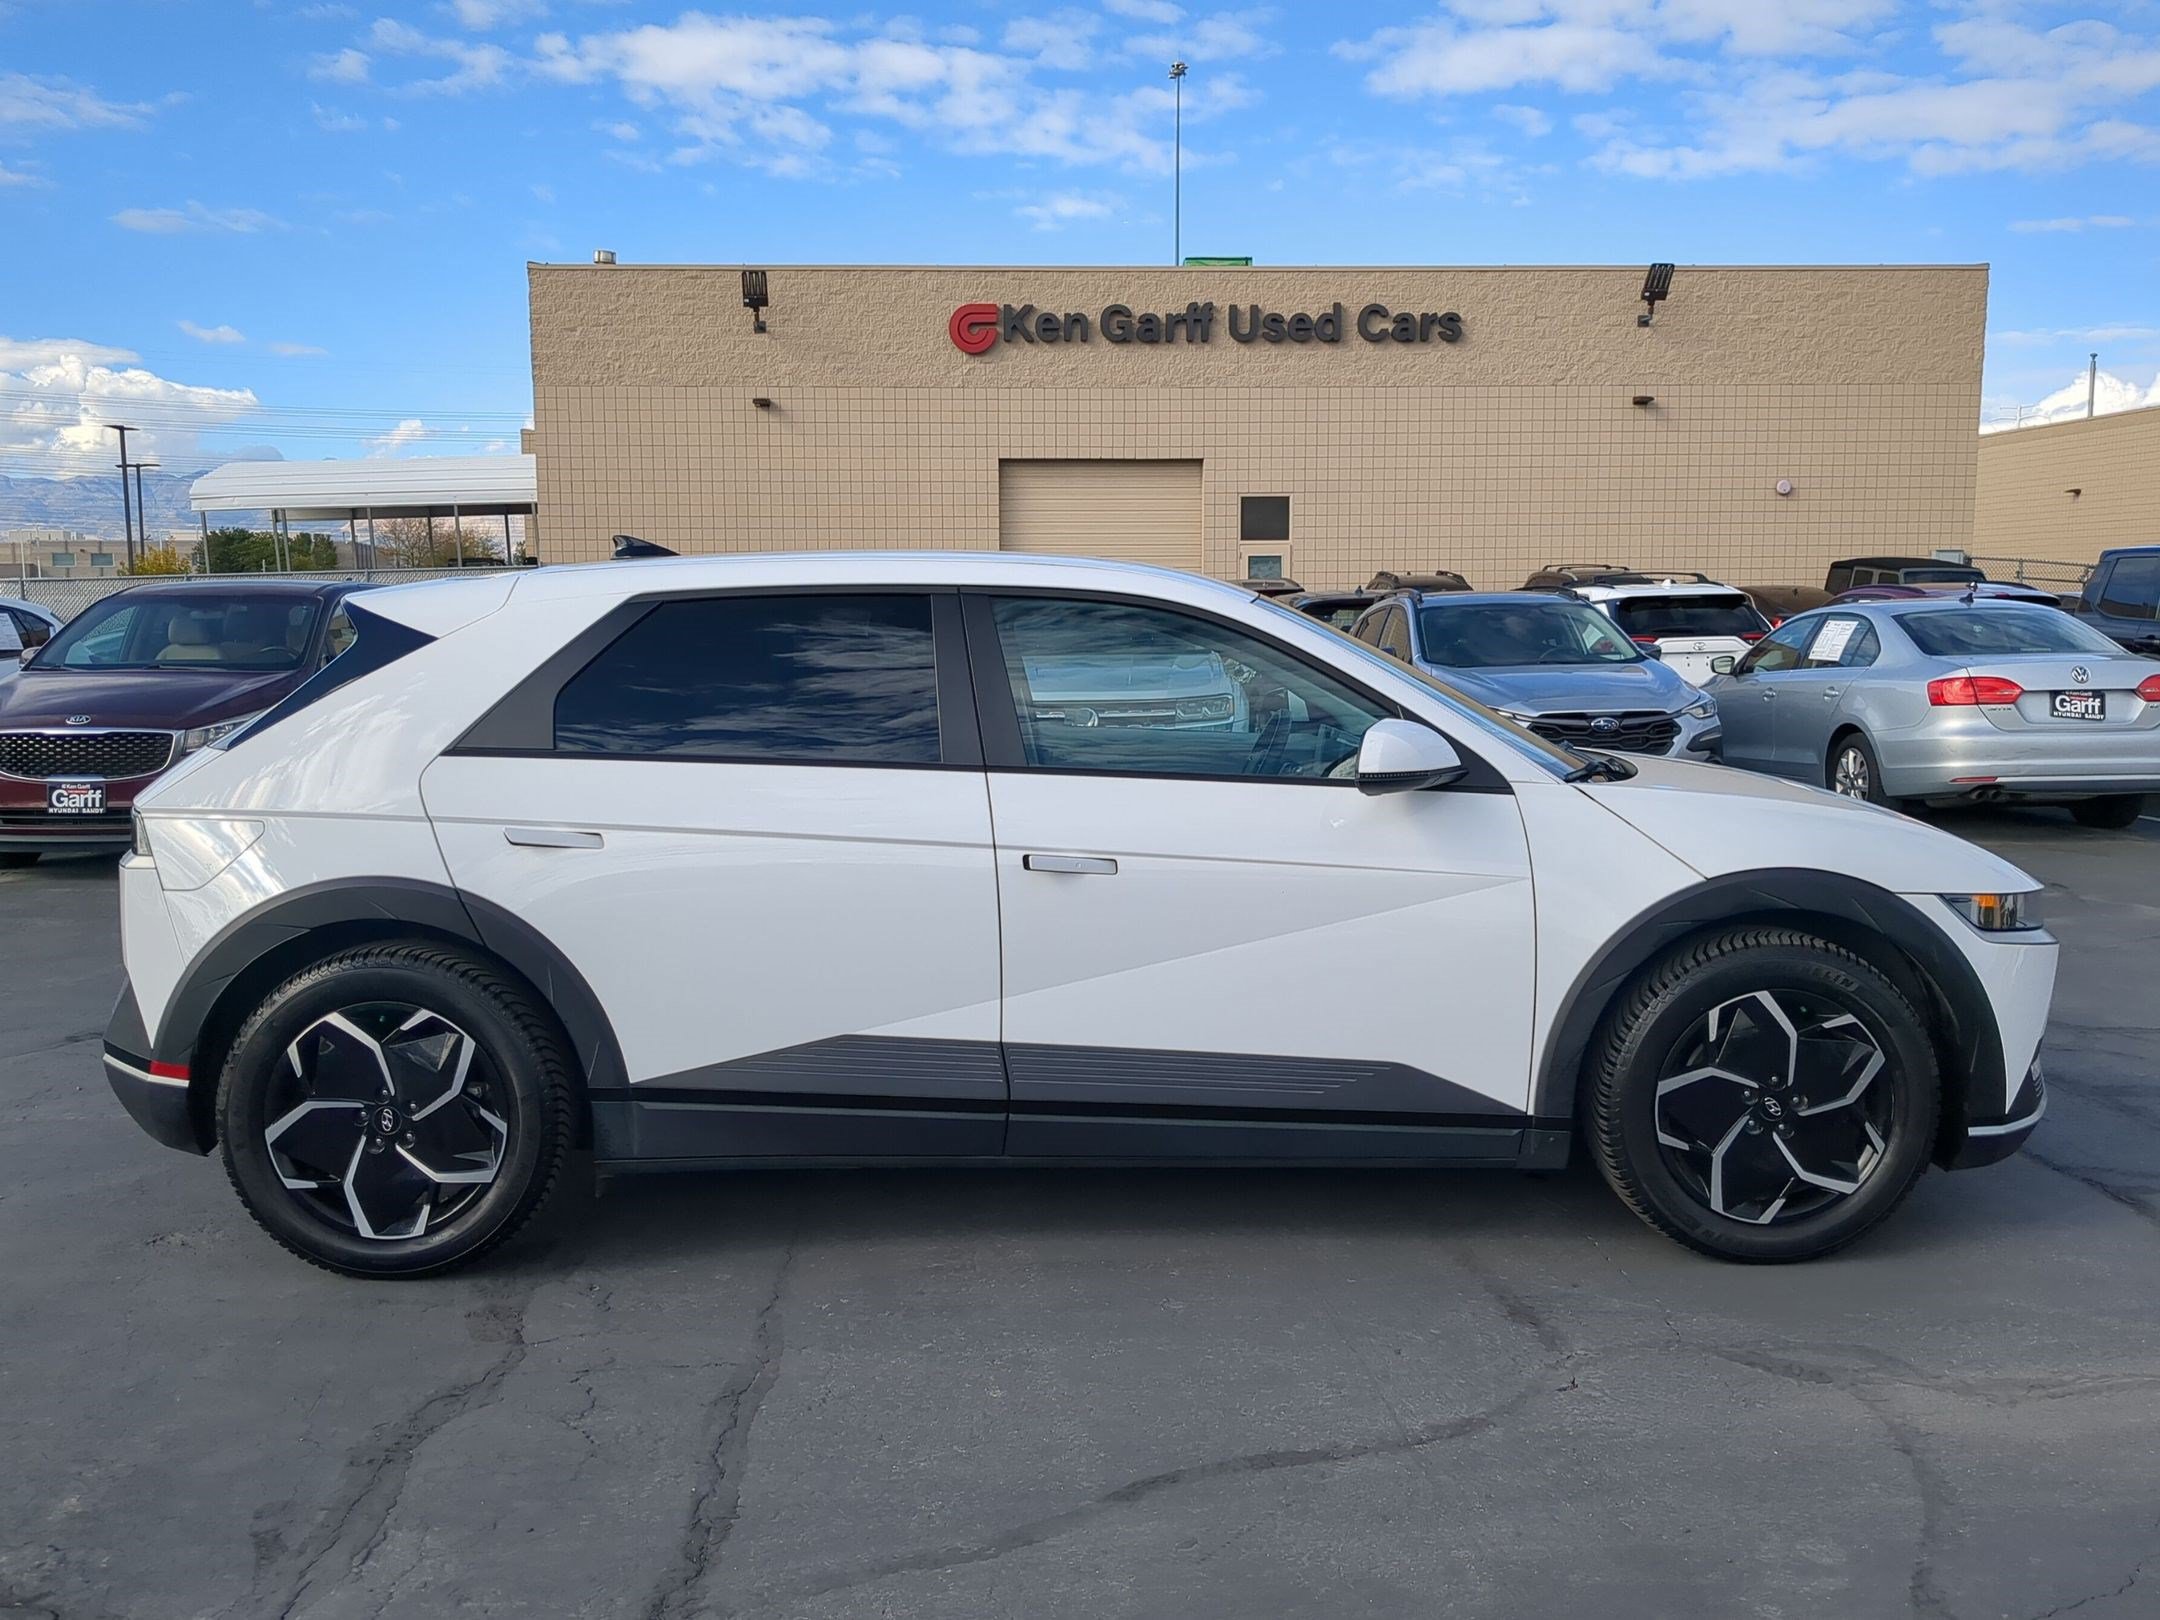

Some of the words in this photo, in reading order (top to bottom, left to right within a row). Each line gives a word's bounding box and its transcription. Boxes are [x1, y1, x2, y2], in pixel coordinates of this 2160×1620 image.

[1003, 304, 1089, 342] Ken
[1100, 302, 1213, 343] Garff
[1229, 302, 1342, 343] Used
[1357, 303, 1462, 343] Cars
[2055, 695, 2101, 714] Garff
[51, 789, 102, 808] Garff
